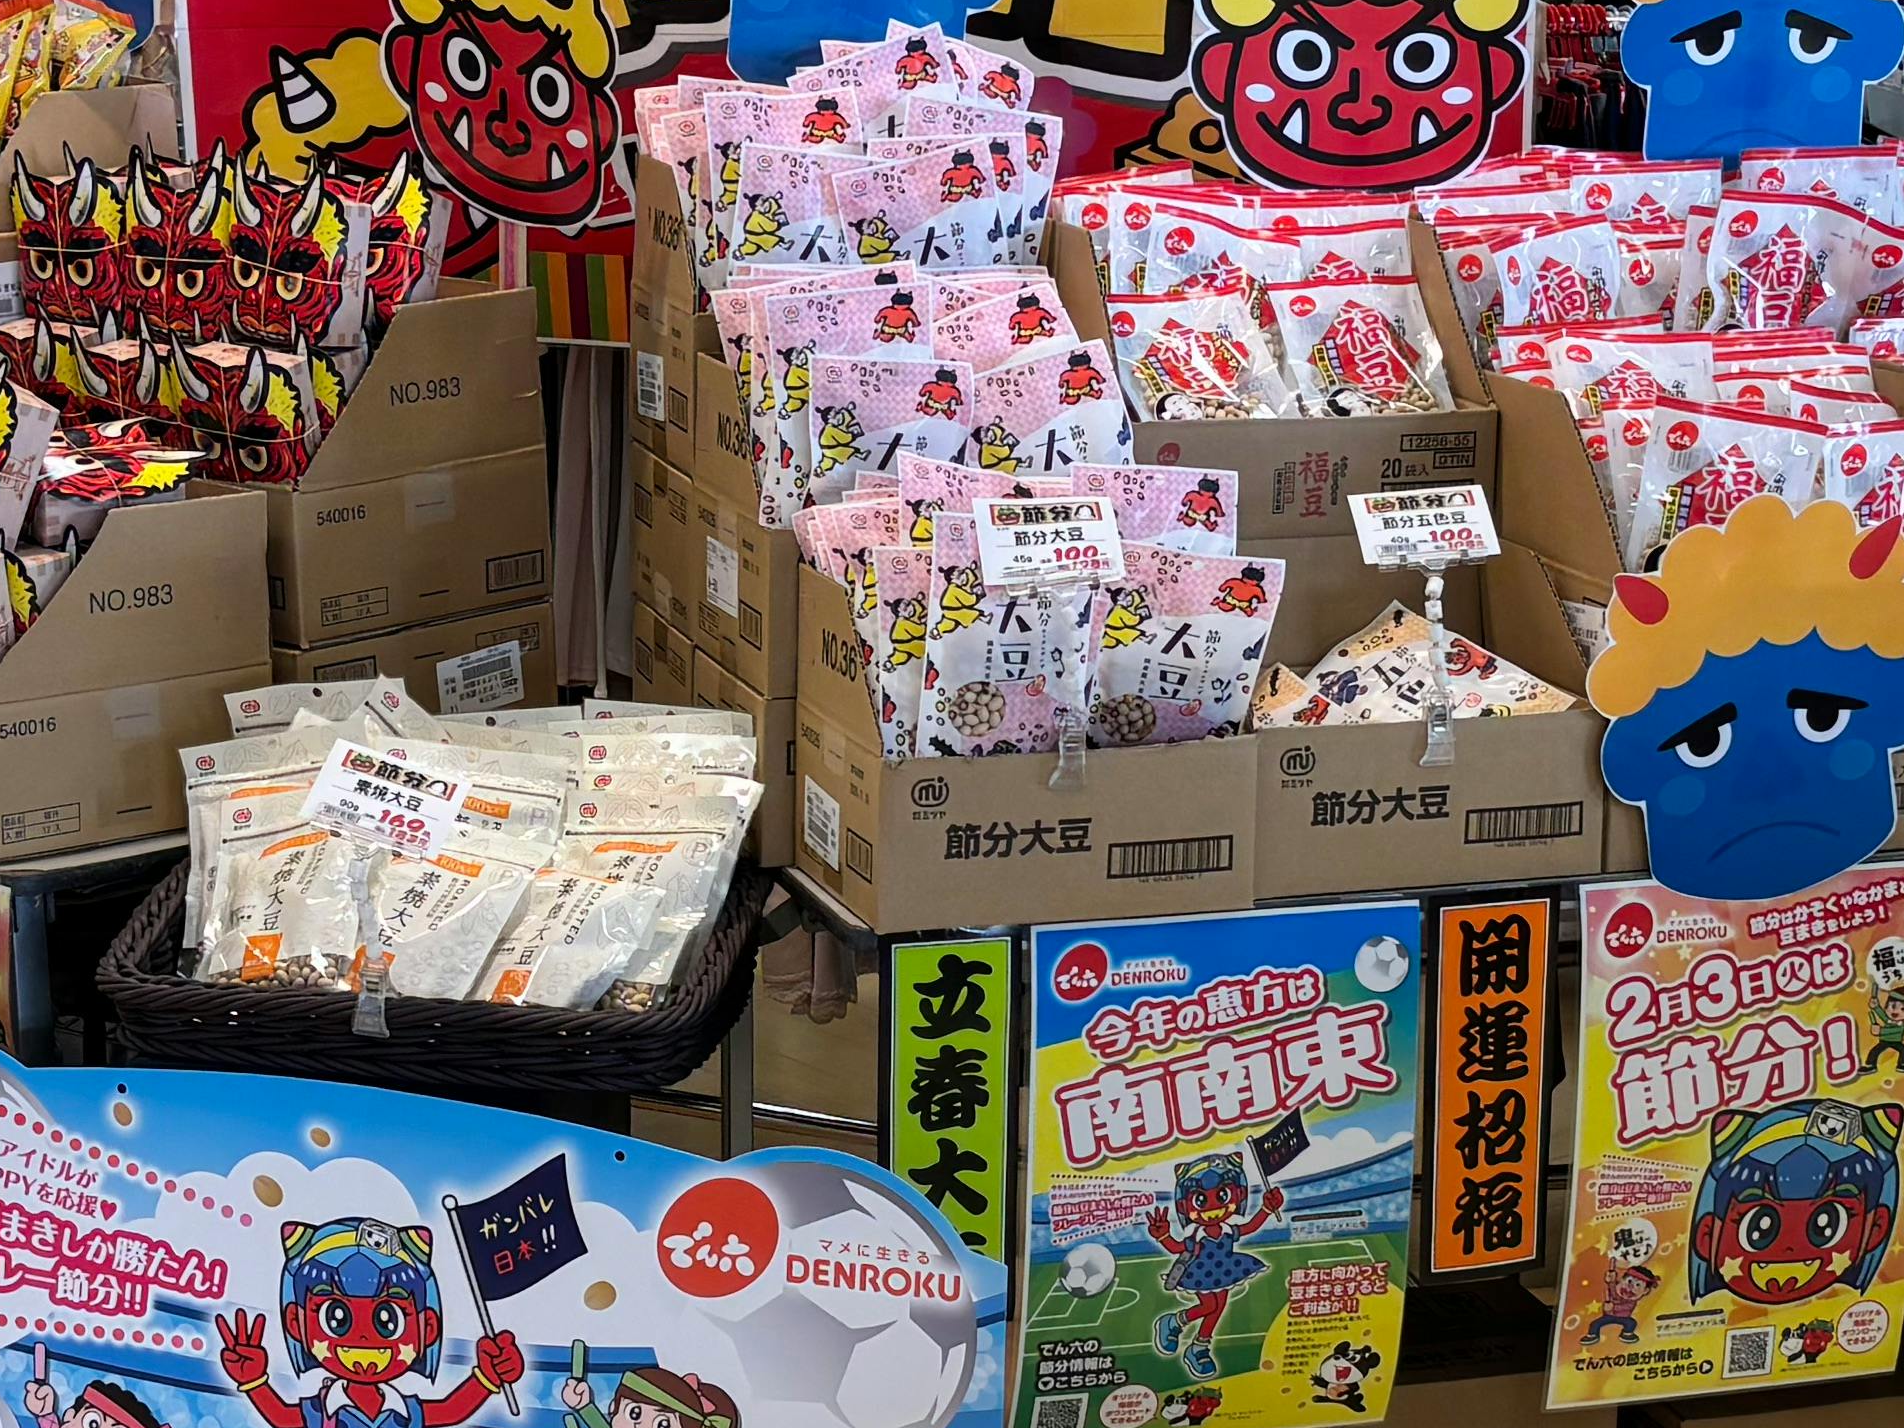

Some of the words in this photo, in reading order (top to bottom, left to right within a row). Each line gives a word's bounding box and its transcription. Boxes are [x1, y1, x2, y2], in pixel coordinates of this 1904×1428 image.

[389, 376, 461, 408] NO.983
[315, 503, 367, 527] 540016
[1398, 493, 1445, 511] 節分
[1013, 525, 1085, 547] 節分大豆
[1381, 511, 1468, 531] 節分五色豆
[89, 584, 173, 615] NO.983
[1202, 628, 1223, 660] 節分
[1148, 621, 1201, 703] 大豆
[352, 778, 423, 812] 素焼大豆
[1310, 782, 1450, 827] 節分大豆
[943, 817, 1093, 863] 節分大豆
[1656, 923, 1728, 942] DENROKU
[1777, 903, 1889, 947] 豆まきをしよう!
[1109, 964, 1188, 986] DENROKU
[1088, 972, 1320, 1056] 今年の恵方は
[1060, 1010, 1392, 1160] 南南東
[1452, 913, 1533, 1259] 開運招福
[1618, 1019, 1860, 1146] 節分!
[479, 1192, 556, 1243] ガンバレ
[660, 1228, 757, 1280] でん六
[817, 1238, 933, 1267] マメに生きる
[784, 1255, 963, 1304] DENROKU
[1039, 1338, 1099, 1355] でん六の
[1572, 1346, 1695, 1372] でん六の節分情報は
[1039, 1355, 1113, 1375] 節分情報は
